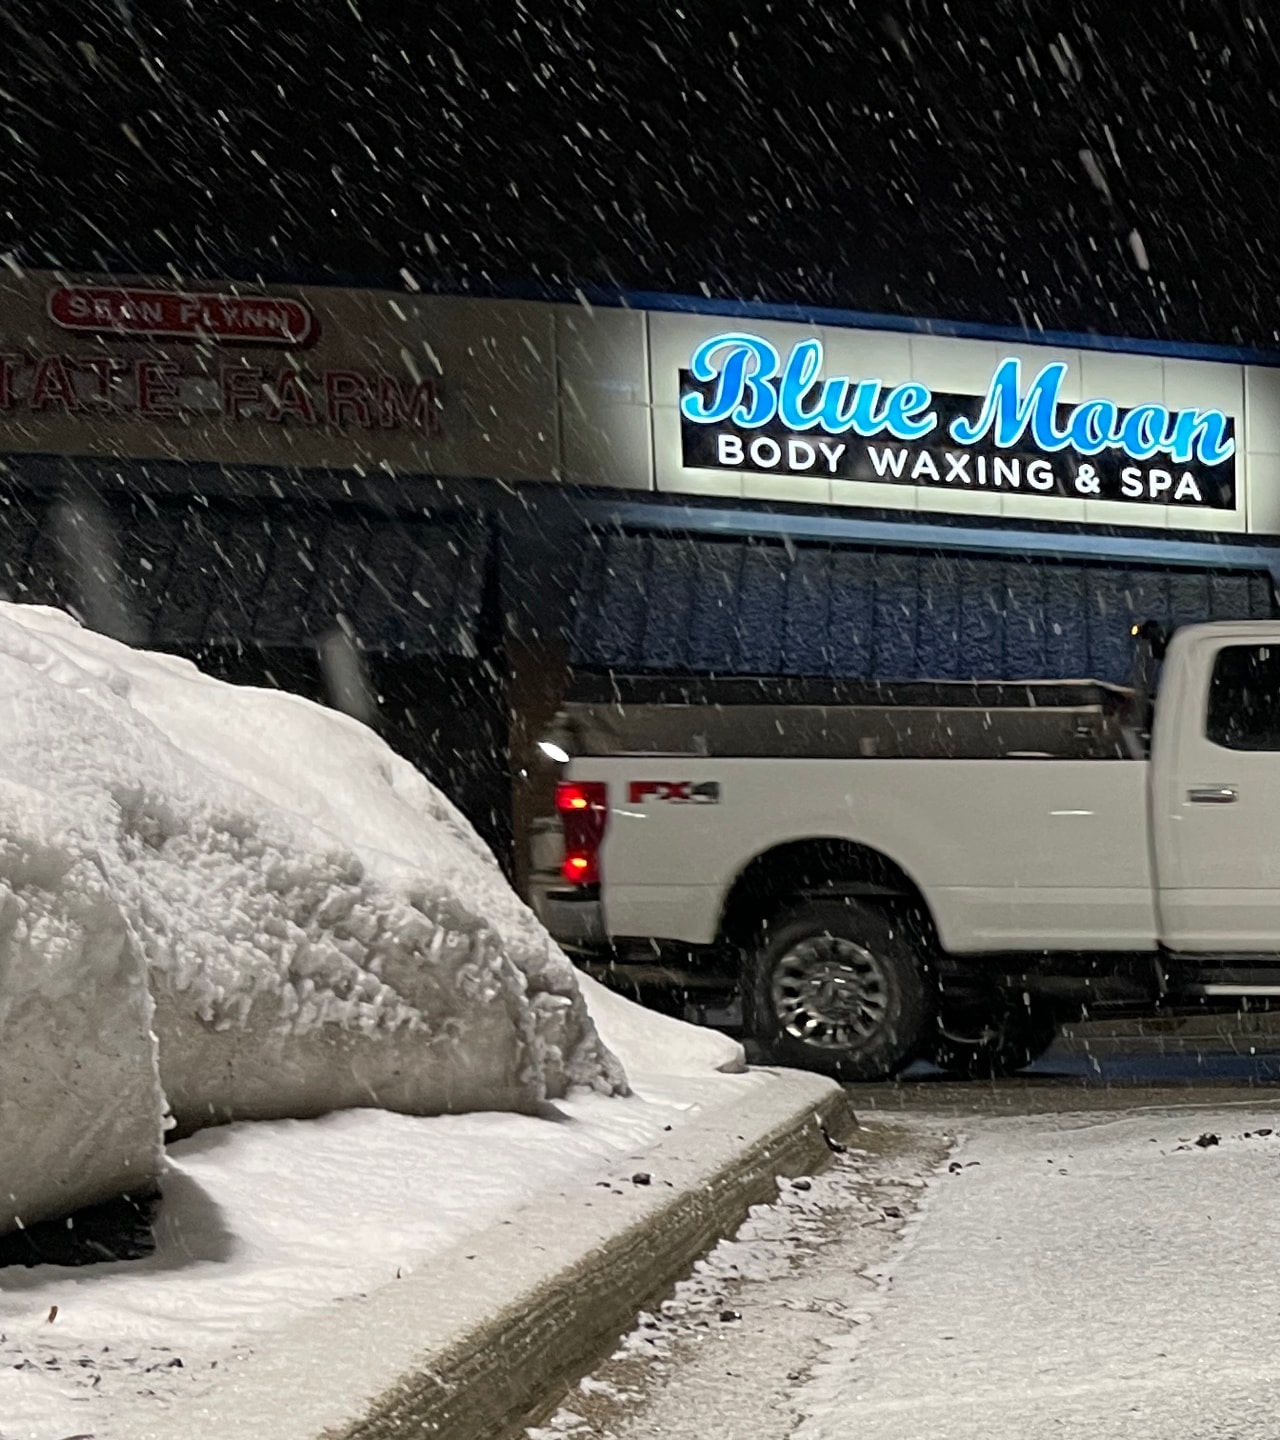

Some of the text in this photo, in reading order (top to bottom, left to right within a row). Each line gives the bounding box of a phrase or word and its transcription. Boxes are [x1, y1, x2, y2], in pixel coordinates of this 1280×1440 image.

[68, 297, 290, 331] SEAN FLYNN
[220, 365, 441, 436] FARM
[680, 332, 1235, 466] Blue Moon
[717, 434, 1203, 502] BODY WAXING & SPA
[629, 781, 720, 804] FX4
